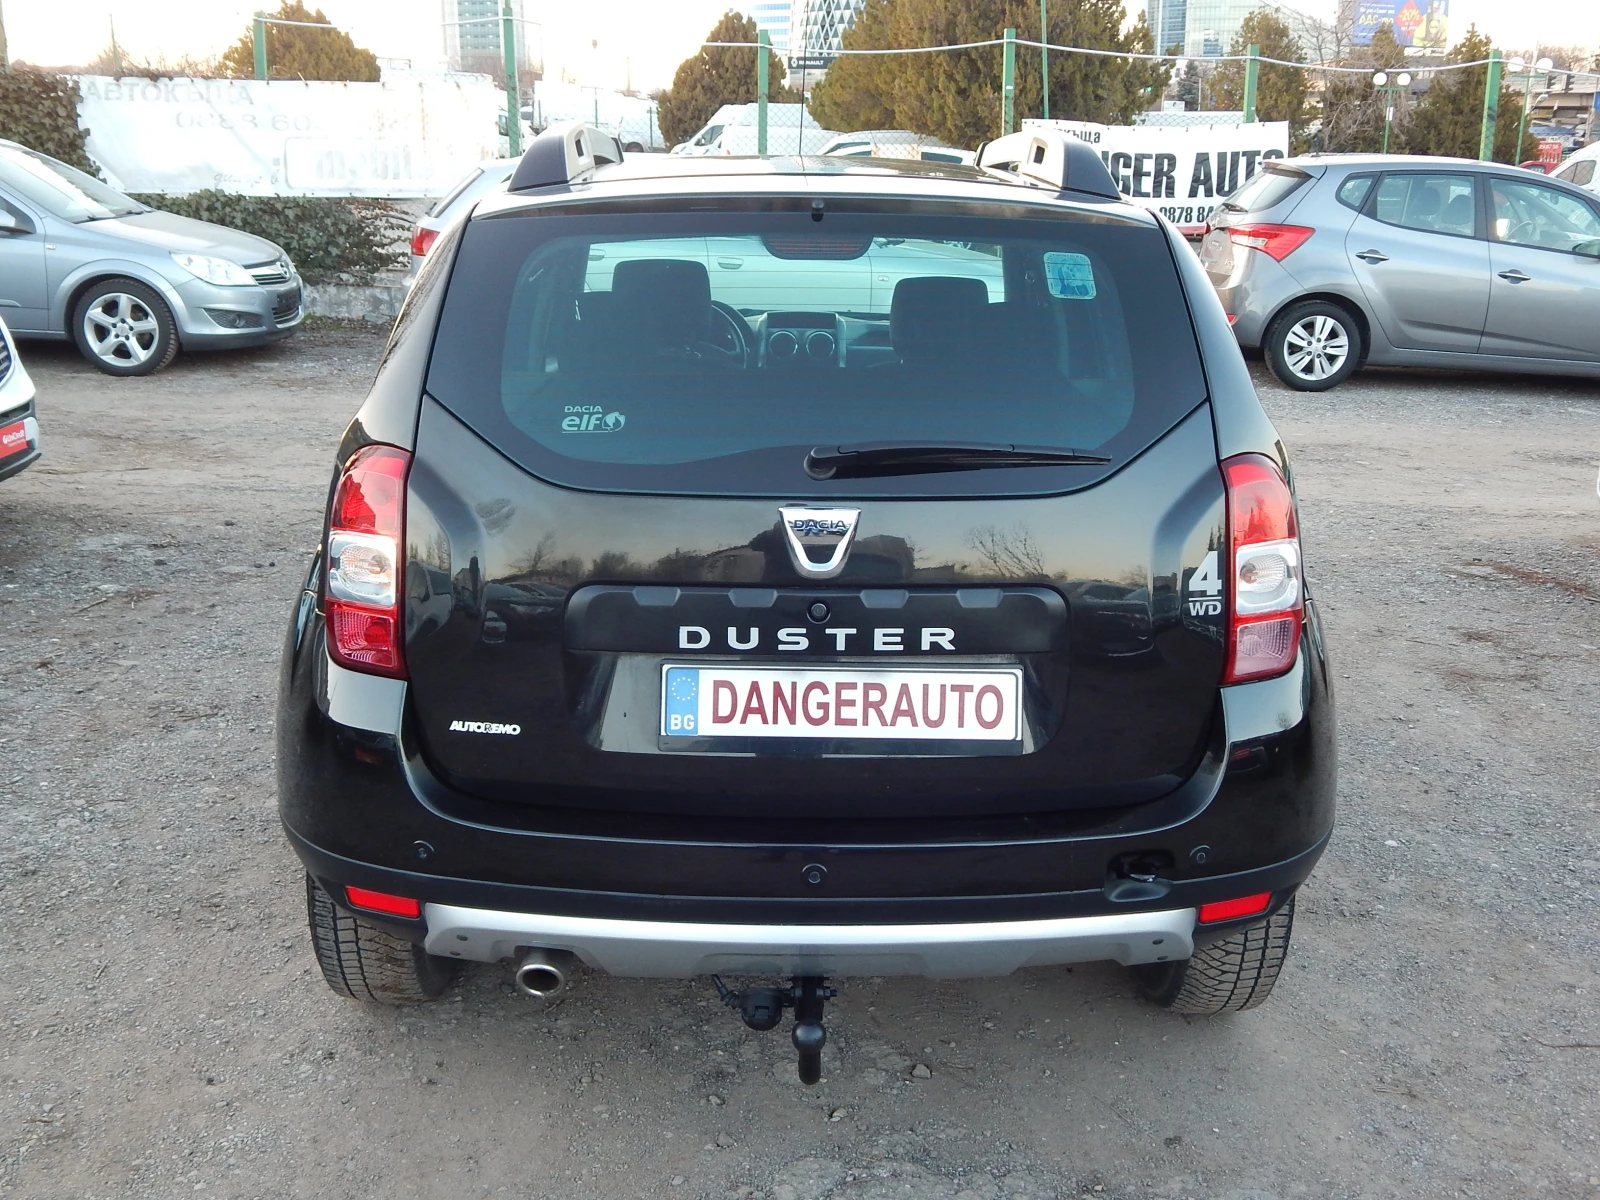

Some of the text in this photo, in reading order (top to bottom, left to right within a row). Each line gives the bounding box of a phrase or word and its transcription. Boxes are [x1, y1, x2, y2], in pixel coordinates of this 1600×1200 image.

[1187, 149, 1285, 198] AUT
[564, 405, 603, 413] DACIA
[561, 413, 603, 431] elf
[793, 519, 847, 530] DACIA
[1188, 550, 1222, 596] 4
[1188, 601, 1222, 617] WD
[678, 626, 957, 651] DUSTER
[711, 679, 1004, 730] DANGERAUTO
[449, 720, 521, 736] AUTOREMO
[669, 713, 696, 732] BG
